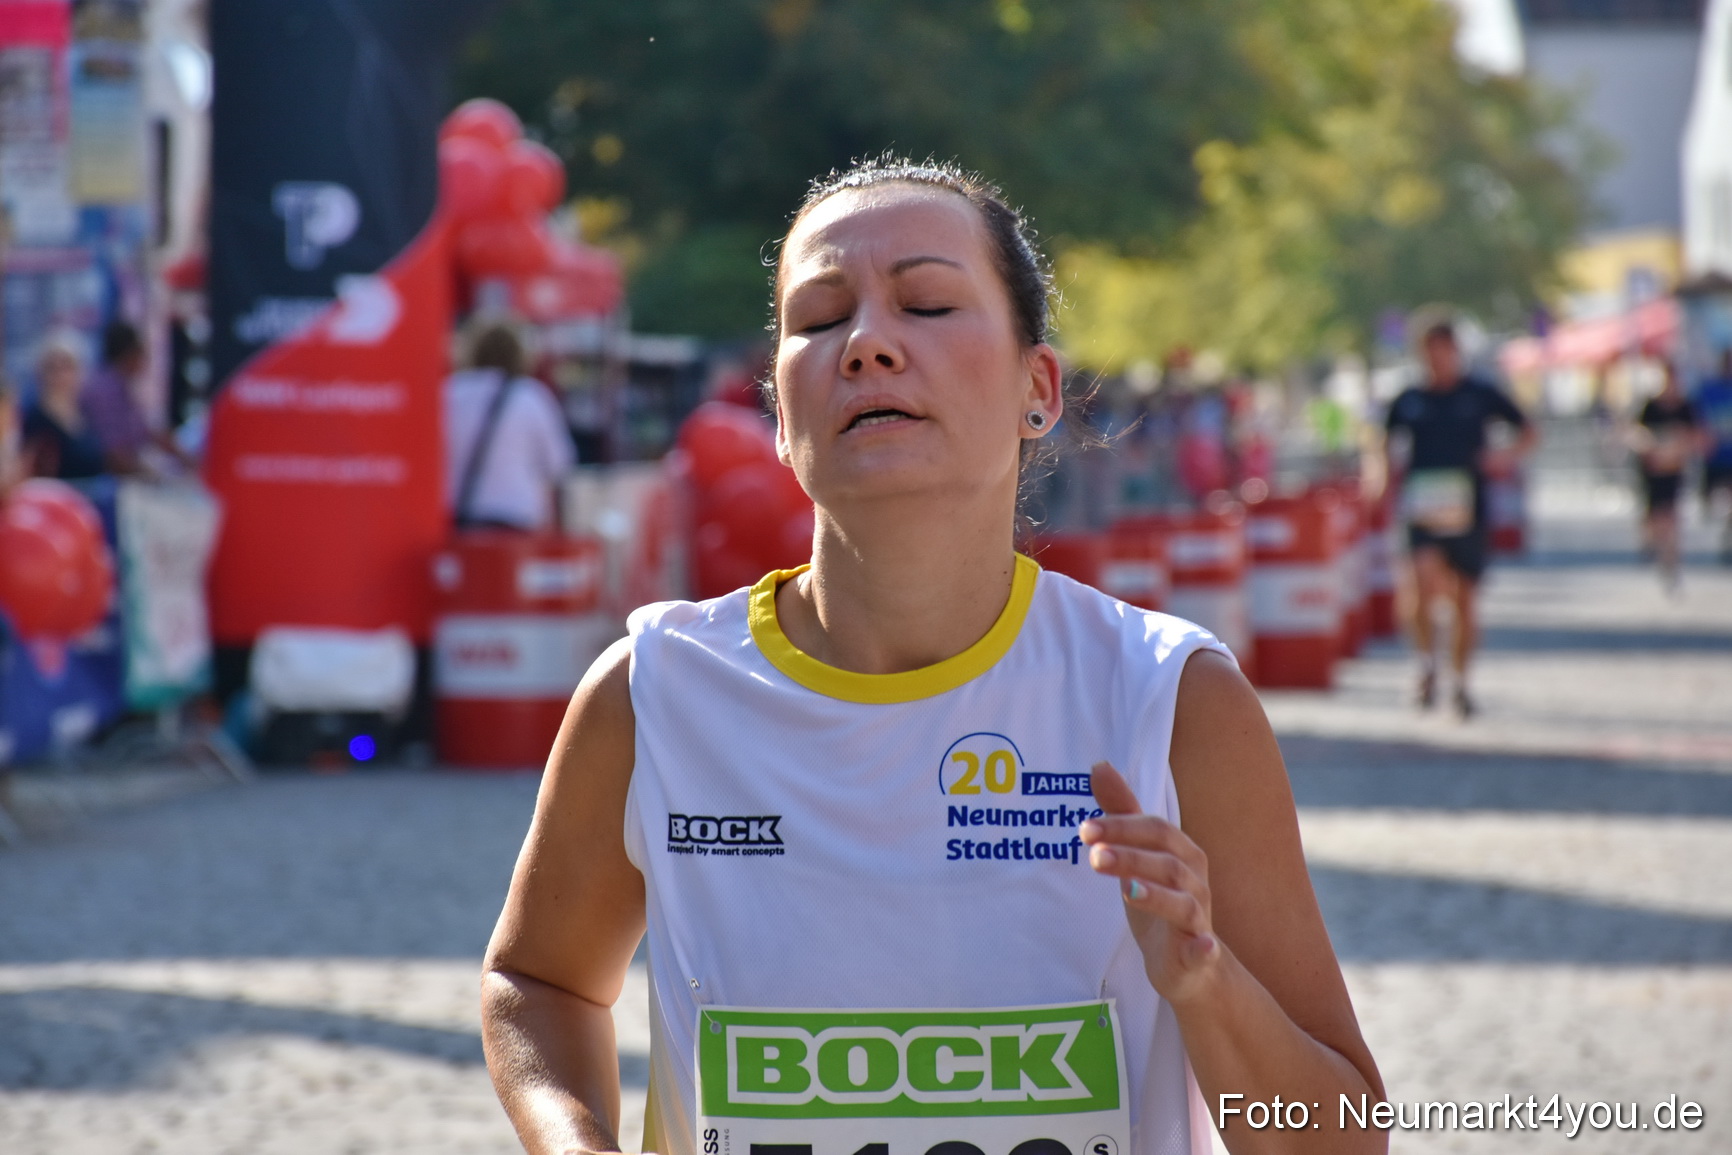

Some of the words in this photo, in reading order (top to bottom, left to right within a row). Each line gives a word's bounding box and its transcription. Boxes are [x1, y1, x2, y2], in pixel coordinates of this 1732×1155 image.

[949, 749, 1016, 795] 20
[1028, 776, 1089, 794] JAHRE
[668, 813, 784, 845] BOCK
[697, 845, 709, 856] by
[711, 847, 740, 856] smart
[742, 847, 785, 857] concepts
[946, 837, 1083, 865] Stadtlauf
[726, 1020, 1093, 1103] BOCK
